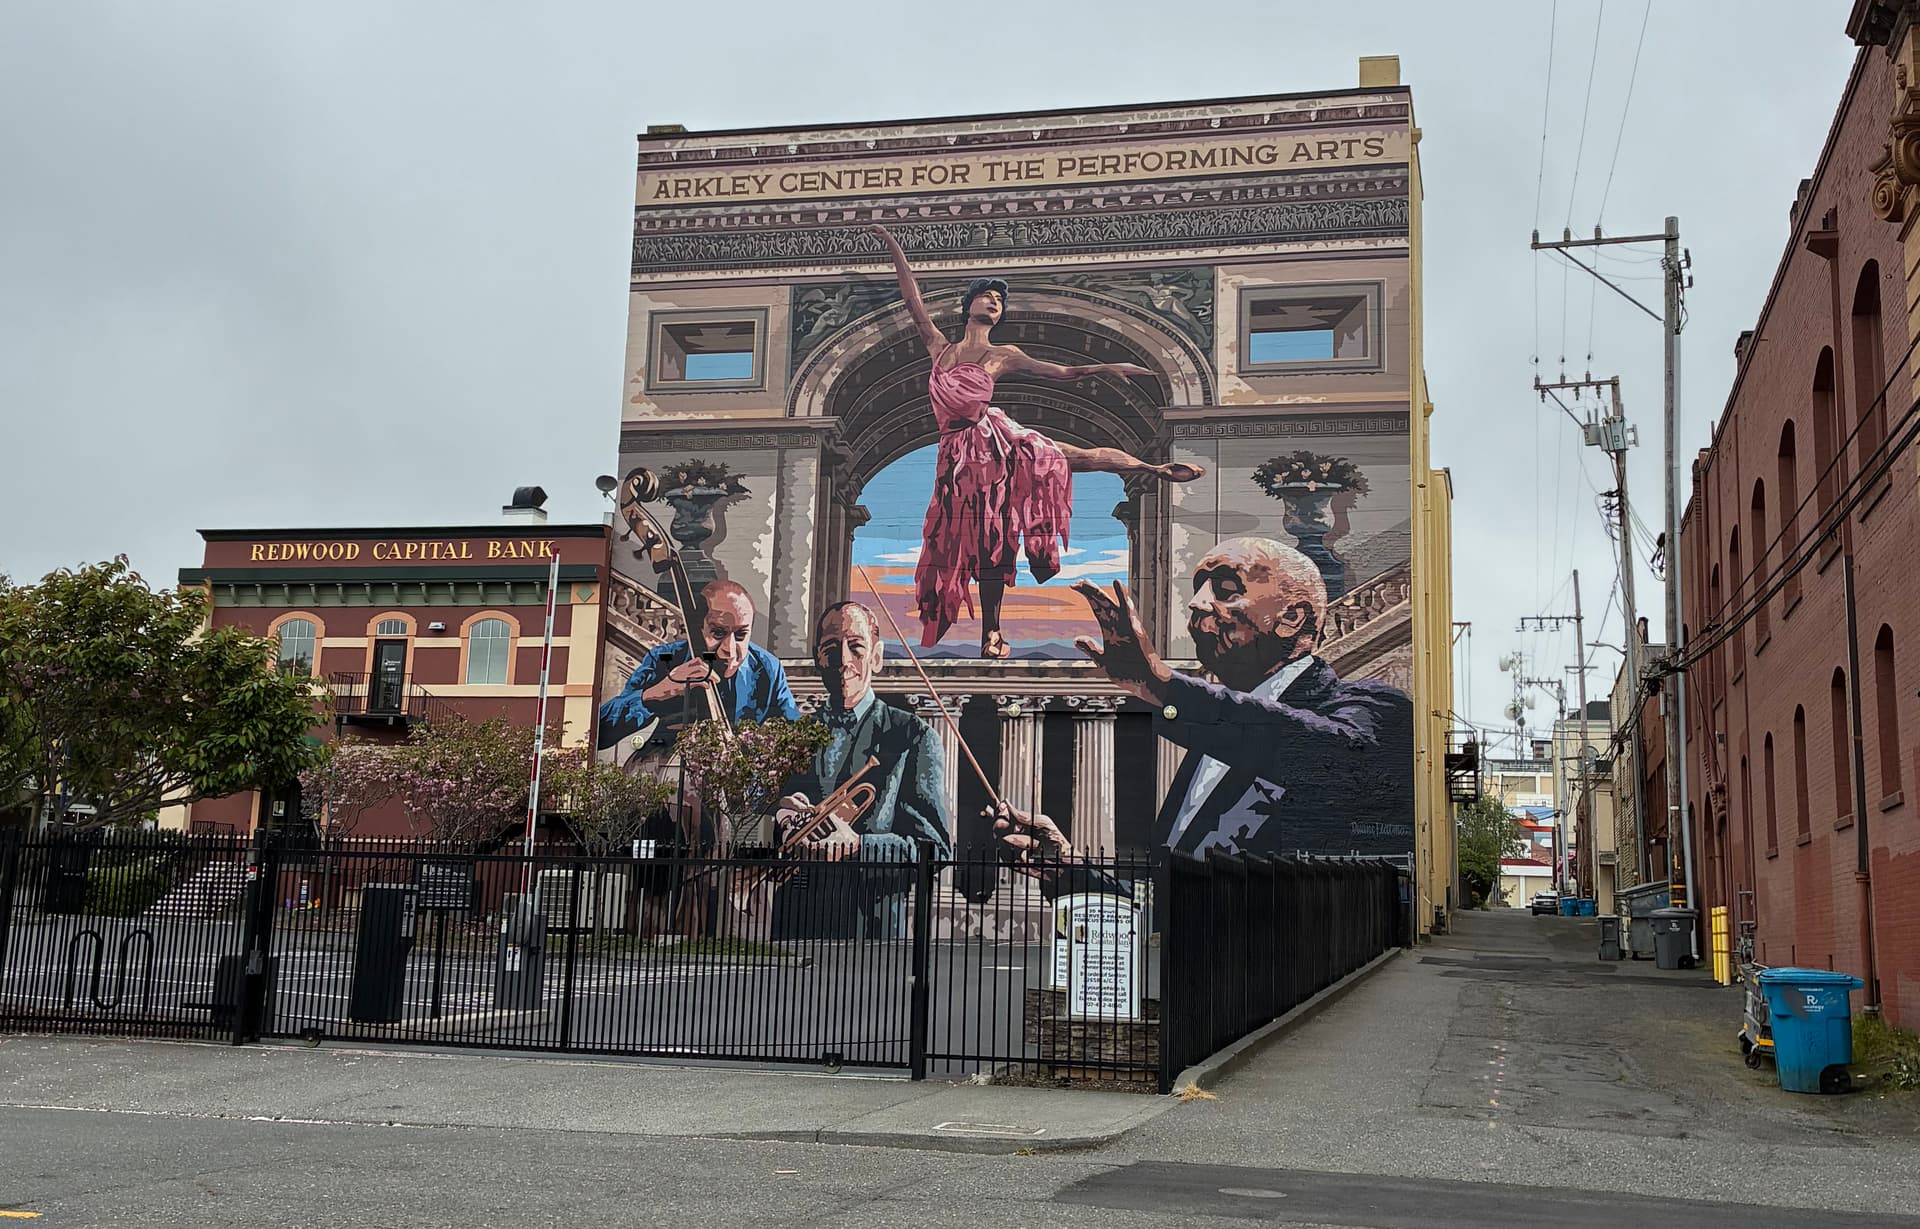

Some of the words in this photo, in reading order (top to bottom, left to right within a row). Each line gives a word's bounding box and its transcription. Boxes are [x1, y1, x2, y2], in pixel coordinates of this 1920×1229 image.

[652, 174, 773, 200] ARKLEY
[778, 167, 903, 194] CENTER
[911, 164, 970, 186] FOR
[982, 158, 1045, 182] THE
[1056, 144, 1279, 178] PERFORMING
[1288, 137, 1385, 163] ARTS
[250, 542, 361, 562] REDWOOD
[372, 541, 474, 561] CAPITAL
[487, 540, 556, 559] BANK
